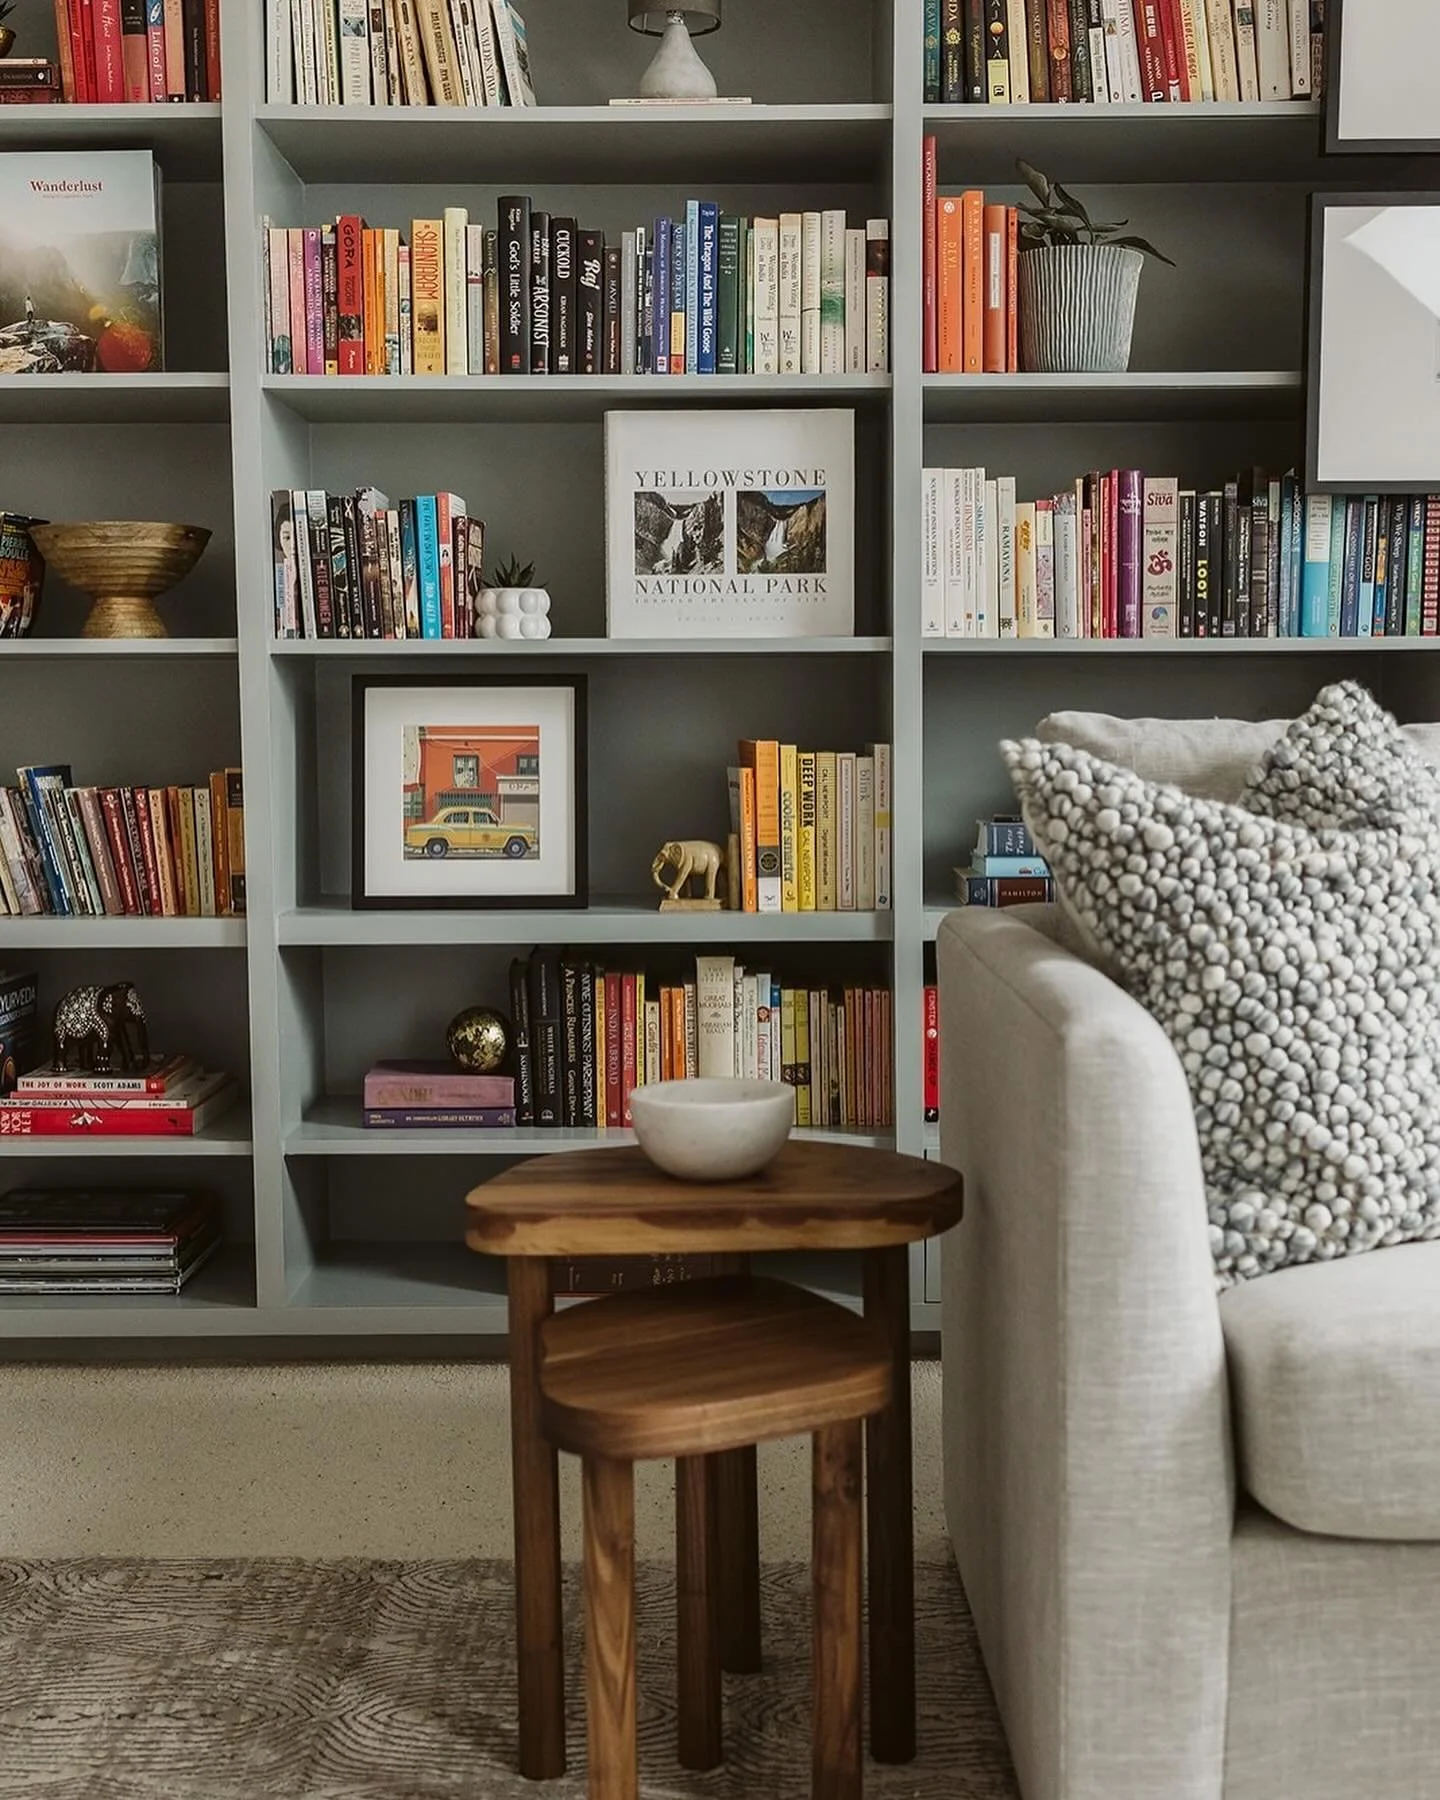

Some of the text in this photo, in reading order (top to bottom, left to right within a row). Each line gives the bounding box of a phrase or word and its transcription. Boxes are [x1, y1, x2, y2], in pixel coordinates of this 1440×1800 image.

[152, 32, 163, 86] Life of Pi
[481, 27, 496, 97] WALDEN TWO
[30, 181, 104, 192] Wanderlust
[925, 150, 933, 206] EXPLAINING
[343, 224, 356, 270] GORA
[413, 230, 438, 300] SHANTARAM
[556, 230, 570, 279] CUCKOLD
[674, 228, 684, 309] QUEEN OF DREAMS
[780, 261, 789, 280] India
[947, 241, 957, 269] DEVI
[508, 240, 521, 335] God's Little Soldier
[580, 259, 601, 290] Raj
[701, 225, 713, 354] The Dragon And The Wild Goose
[758, 263, 767, 282] India
[766, 254, 778, 311] Women Writing
[788, 252, 799, 309] Women Writing
[532, 287, 549, 347] ARSONIST
[634, 469, 827, 488] YELLOWSTONE
[1147, 492, 1173, 506] Siva
[930, 506, 937, 515] OF
[954, 506, 961, 515] OF
[964, 504, 973, 551] HINDUISM
[1392, 504, 1403, 558] Why We Sleep
[930, 541, 938, 577] TRADITION
[1002, 525, 1010, 583] RAMAYANA
[1197, 500, 1208, 600] WATSON LOOT
[1363, 556, 1372, 579] GOD
[1410, 533, 1420, 592] The Selfish Gene
[315, 564, 332, 625] KITE RUNNER
[635, 577, 828, 595] NATIONAL PARK
[821, 768, 829, 783] CAL
[859, 769, 871, 802] blink
[783, 790, 796, 884] cooler smarter
[802, 758, 814, 893] DEEP WORK CAL NEWPORT
[821, 828, 829, 849] Digital
[565, 969, 576, 1062] A PRINCESS REMEMBERS
[546, 1025, 555, 1095] WHITE MUGHALS
[581, 973, 593, 1119] NONE OUTSINGS PARSIPPANY
[609, 1008, 618, 1086] INDIA ABROAD
[624, 1041, 633, 1070] GHAZAL
[21, 1080, 142, 1089] THE JOY OF WORK SCOTT ADAMS
[1, 1112, 10, 1134] NEW
[22, 1112, 32, 1134] KER
